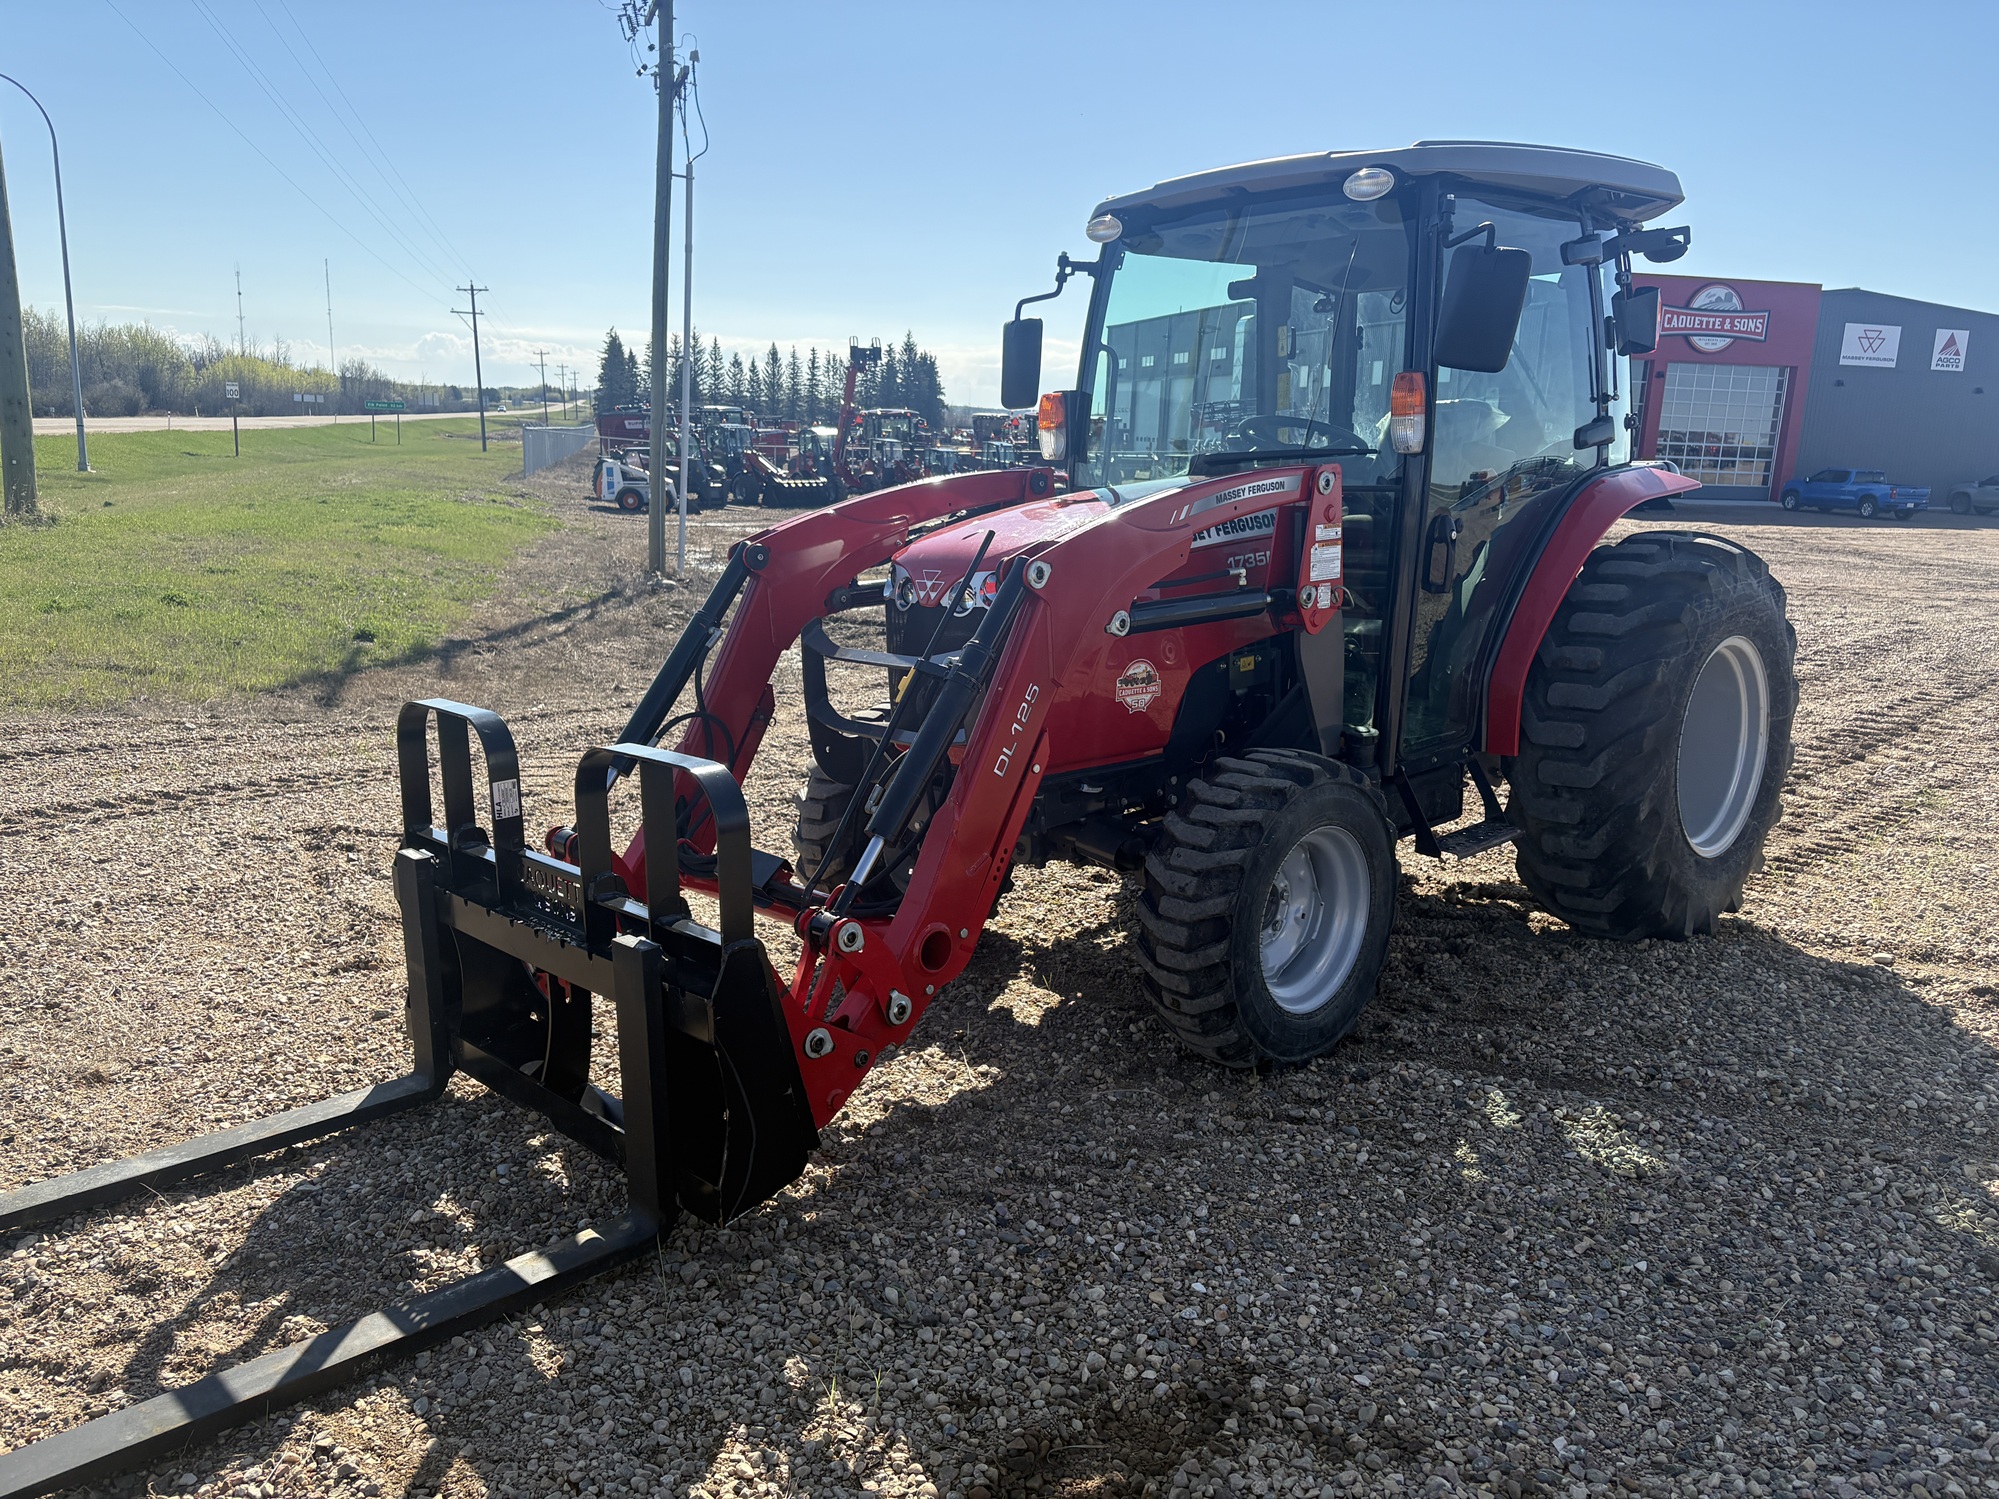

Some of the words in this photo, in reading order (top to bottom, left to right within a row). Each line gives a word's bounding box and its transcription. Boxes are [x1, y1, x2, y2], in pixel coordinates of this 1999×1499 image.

[1663, 313, 1723, 330] CAOUETTE
[1723, 318, 1732, 330] &
[1733, 318, 1763, 333] SONS
[1936, 356, 1960, 364] AGCO
[226, 389, 239, 397] 100
[1215, 487, 1246, 505] MASSEY
[1247, 480, 1285, 496] FERGUSON
[1131, 699, 1146, 709] 50
[495, 801, 503, 819] HLA
